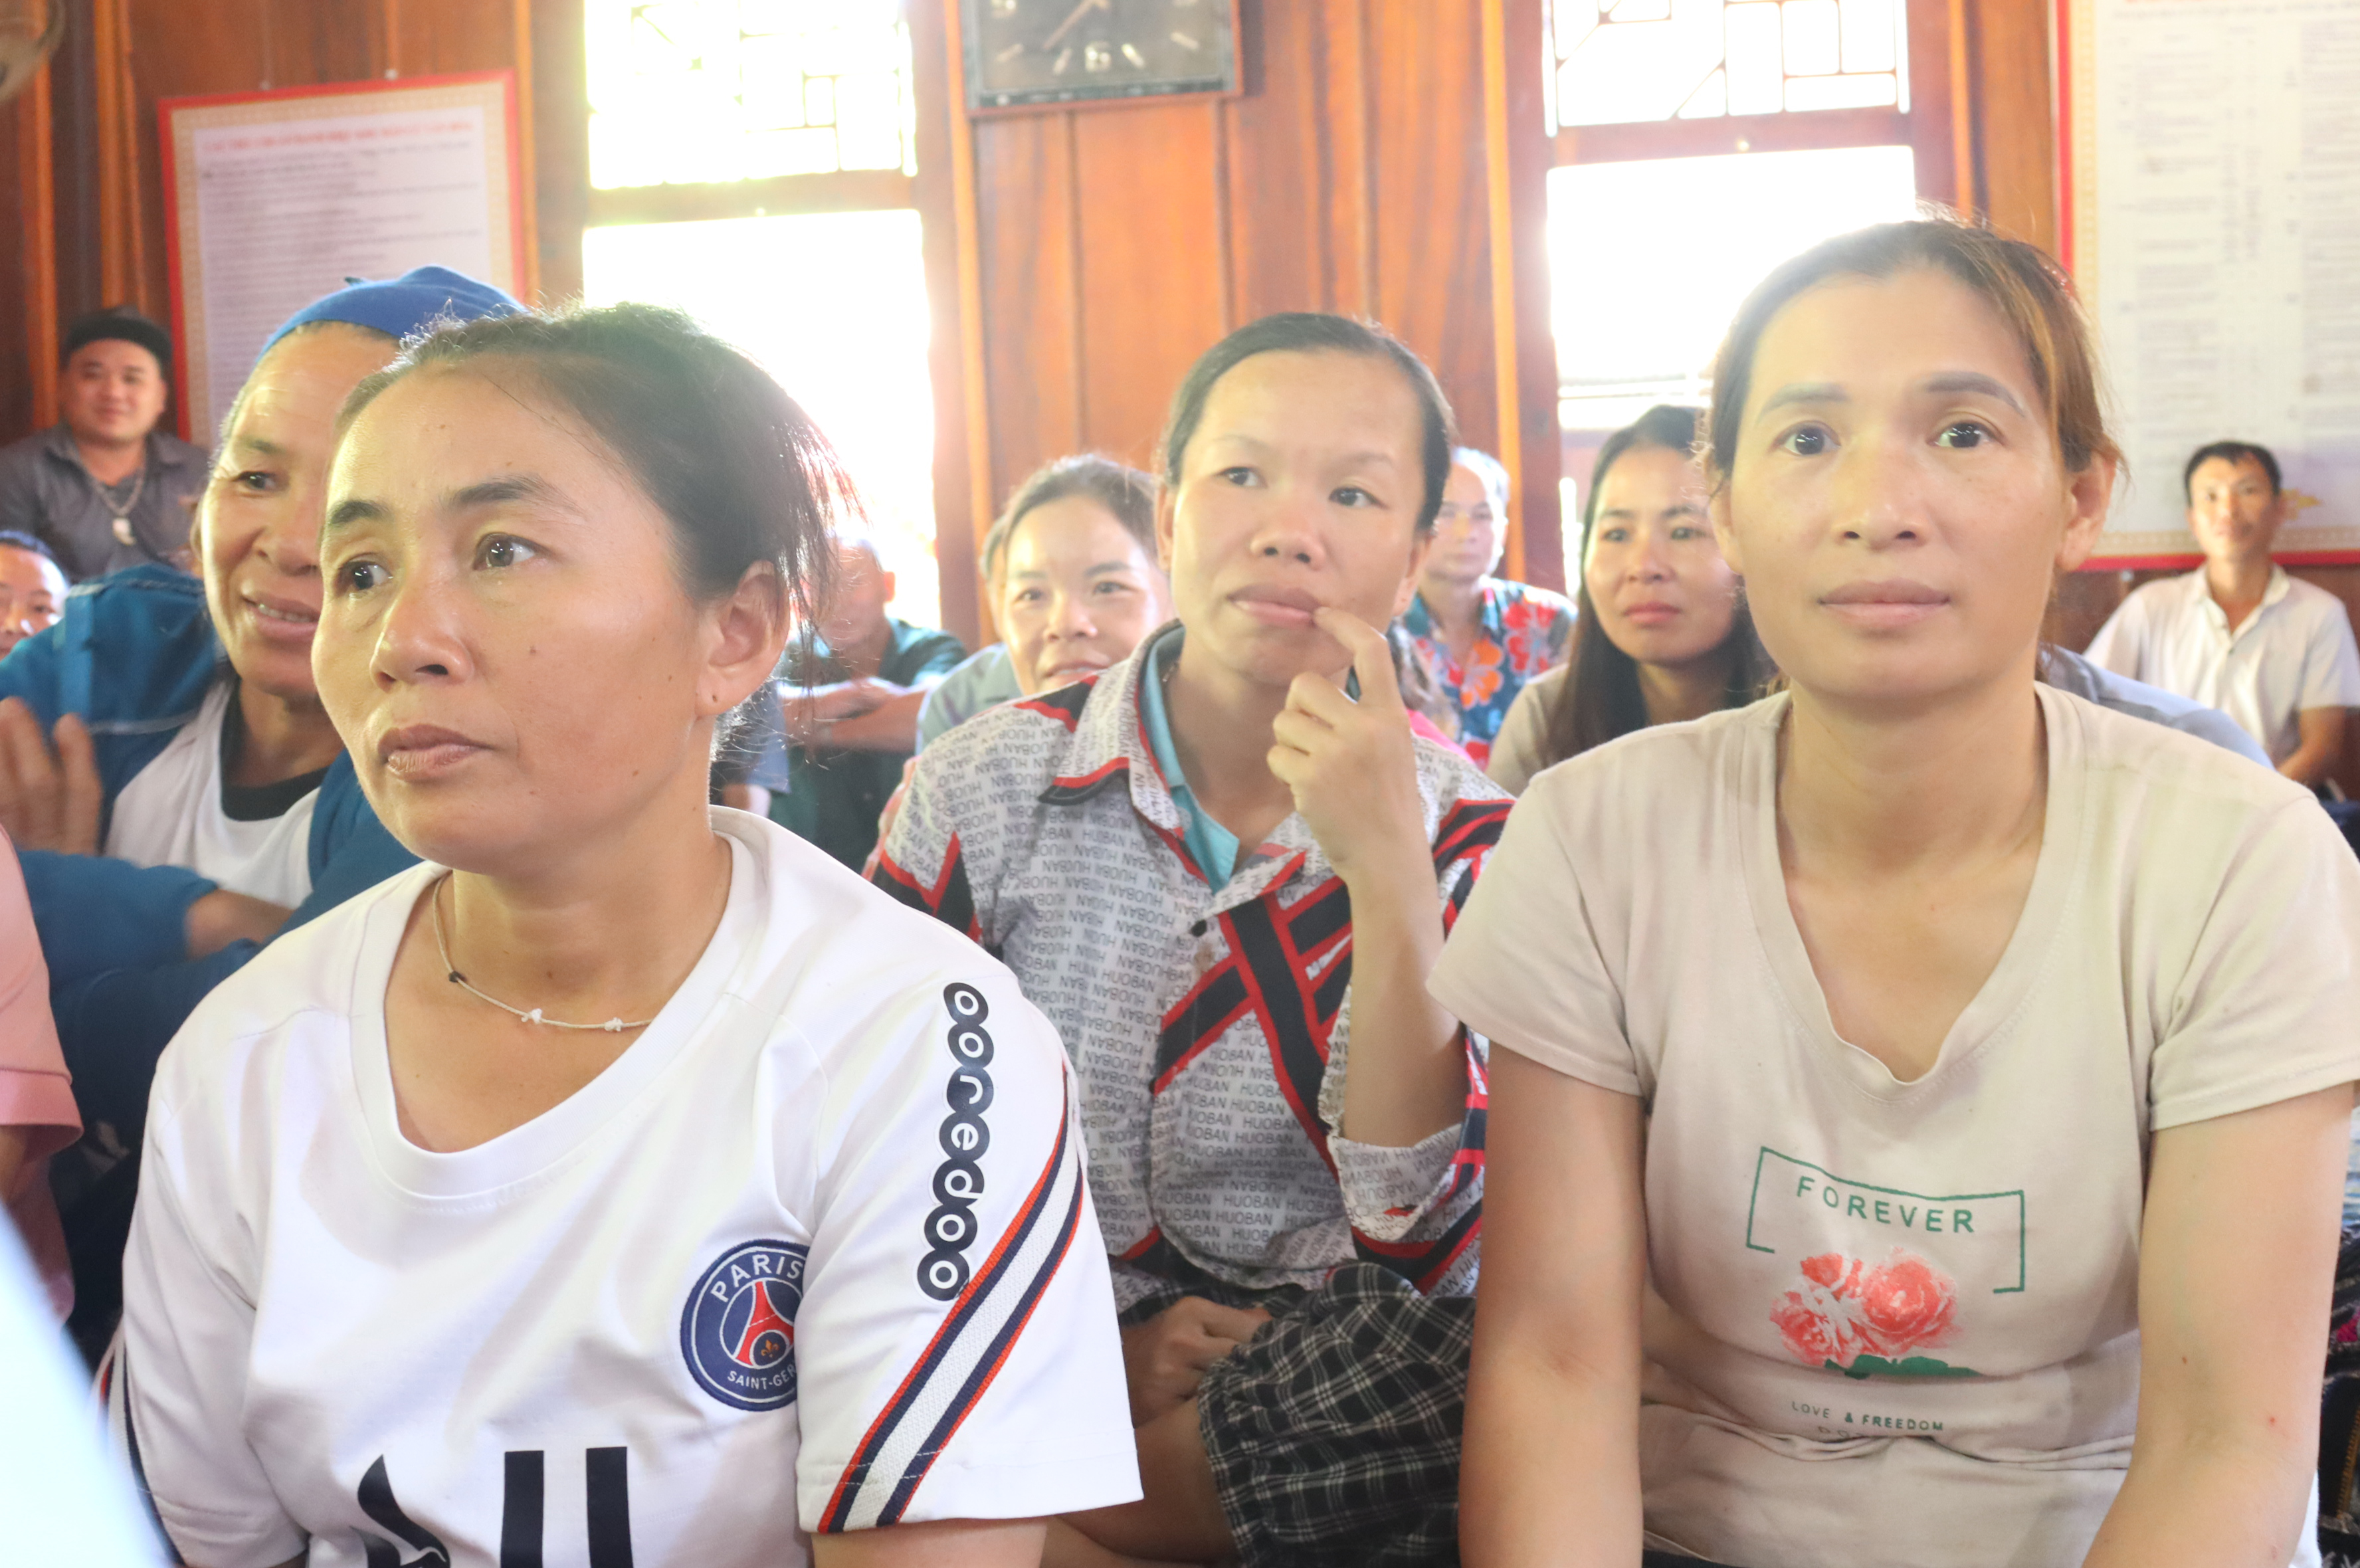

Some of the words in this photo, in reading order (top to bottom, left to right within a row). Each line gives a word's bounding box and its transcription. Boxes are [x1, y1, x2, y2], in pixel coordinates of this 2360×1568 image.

[1109, 883, 1163, 908] HUOBAN
[1118, 903, 1176, 929] HUOBAN
[1114, 920, 1170, 943] HUOBAN
[1121, 938, 1174, 961] HUOBAN
[1102, 969, 1155, 993] HUOBAN
[1092, 984, 1146, 1007] HUOBAN
[1118, 1007, 1163, 1027] UOBAN
[1088, 1034, 1143, 1057] HUOBAN
[1084, 1050, 1141, 1071] HUOBAN
[1240, 1083, 1280, 1098] HUOB
[1230, 1098, 1286, 1116] HUOBAN
[922, 985, 990, 1296] ooredoo
[1234, 1131, 1294, 1145] HUOBAN
[1223, 1195, 1282, 1209] HUOBAN
[1797, 1175, 1975, 1234] FOREVER
[1216, 1211, 1272, 1226] HUOBAN
[1232, 1228, 1274, 1243] HUOB
[710, 1253, 803, 1304] PARIS
[726, 1363, 798, 1391] SAINT-GER
[1791, 1401, 1830, 1419] LOVE
[1844, 1411, 1854, 1424] &
[1862, 1414, 1944, 1432] FREEDOM
